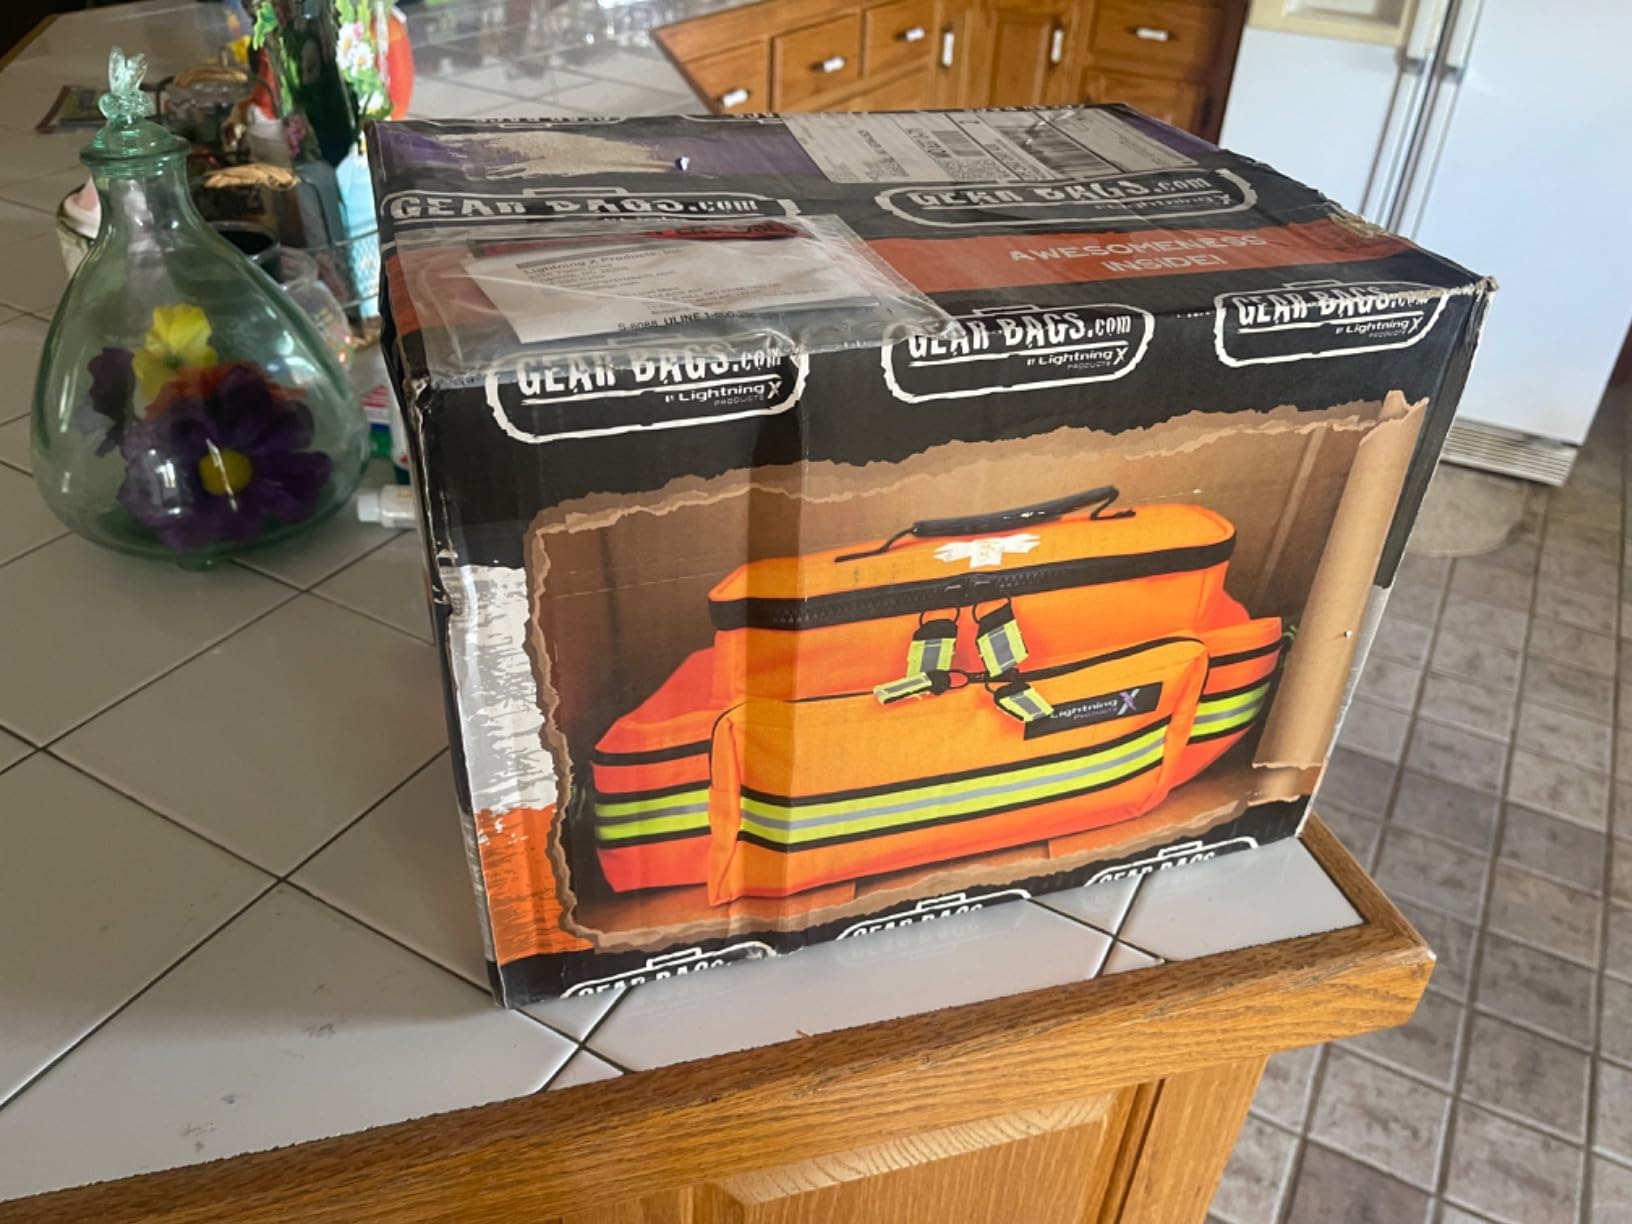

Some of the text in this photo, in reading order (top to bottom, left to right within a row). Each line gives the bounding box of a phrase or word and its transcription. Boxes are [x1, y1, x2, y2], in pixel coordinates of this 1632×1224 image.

[391, 196, 527, 219] GEAR
[906, 189, 1024, 206] GEAR
[1009, 234, 1267, 262] AWESOMENESS
[1101, 253, 1227, 273] INSIDE!
[1232, 292, 1307, 326] GEAR
[908, 312, 1131, 358] GEAR BAGS.com
[1345, 319, 1409, 334] Lightning
[1408, 316, 1424, 335] X
[1038, 349, 1113, 365] Lightning
[1112, 346, 1129, 365] X
[516, 344, 781, 396] GEAR BAGS.com
[678, 384, 765, 402] Lightning
[767, 380, 783, 399] X
[1117, 688, 1140, 716] X
